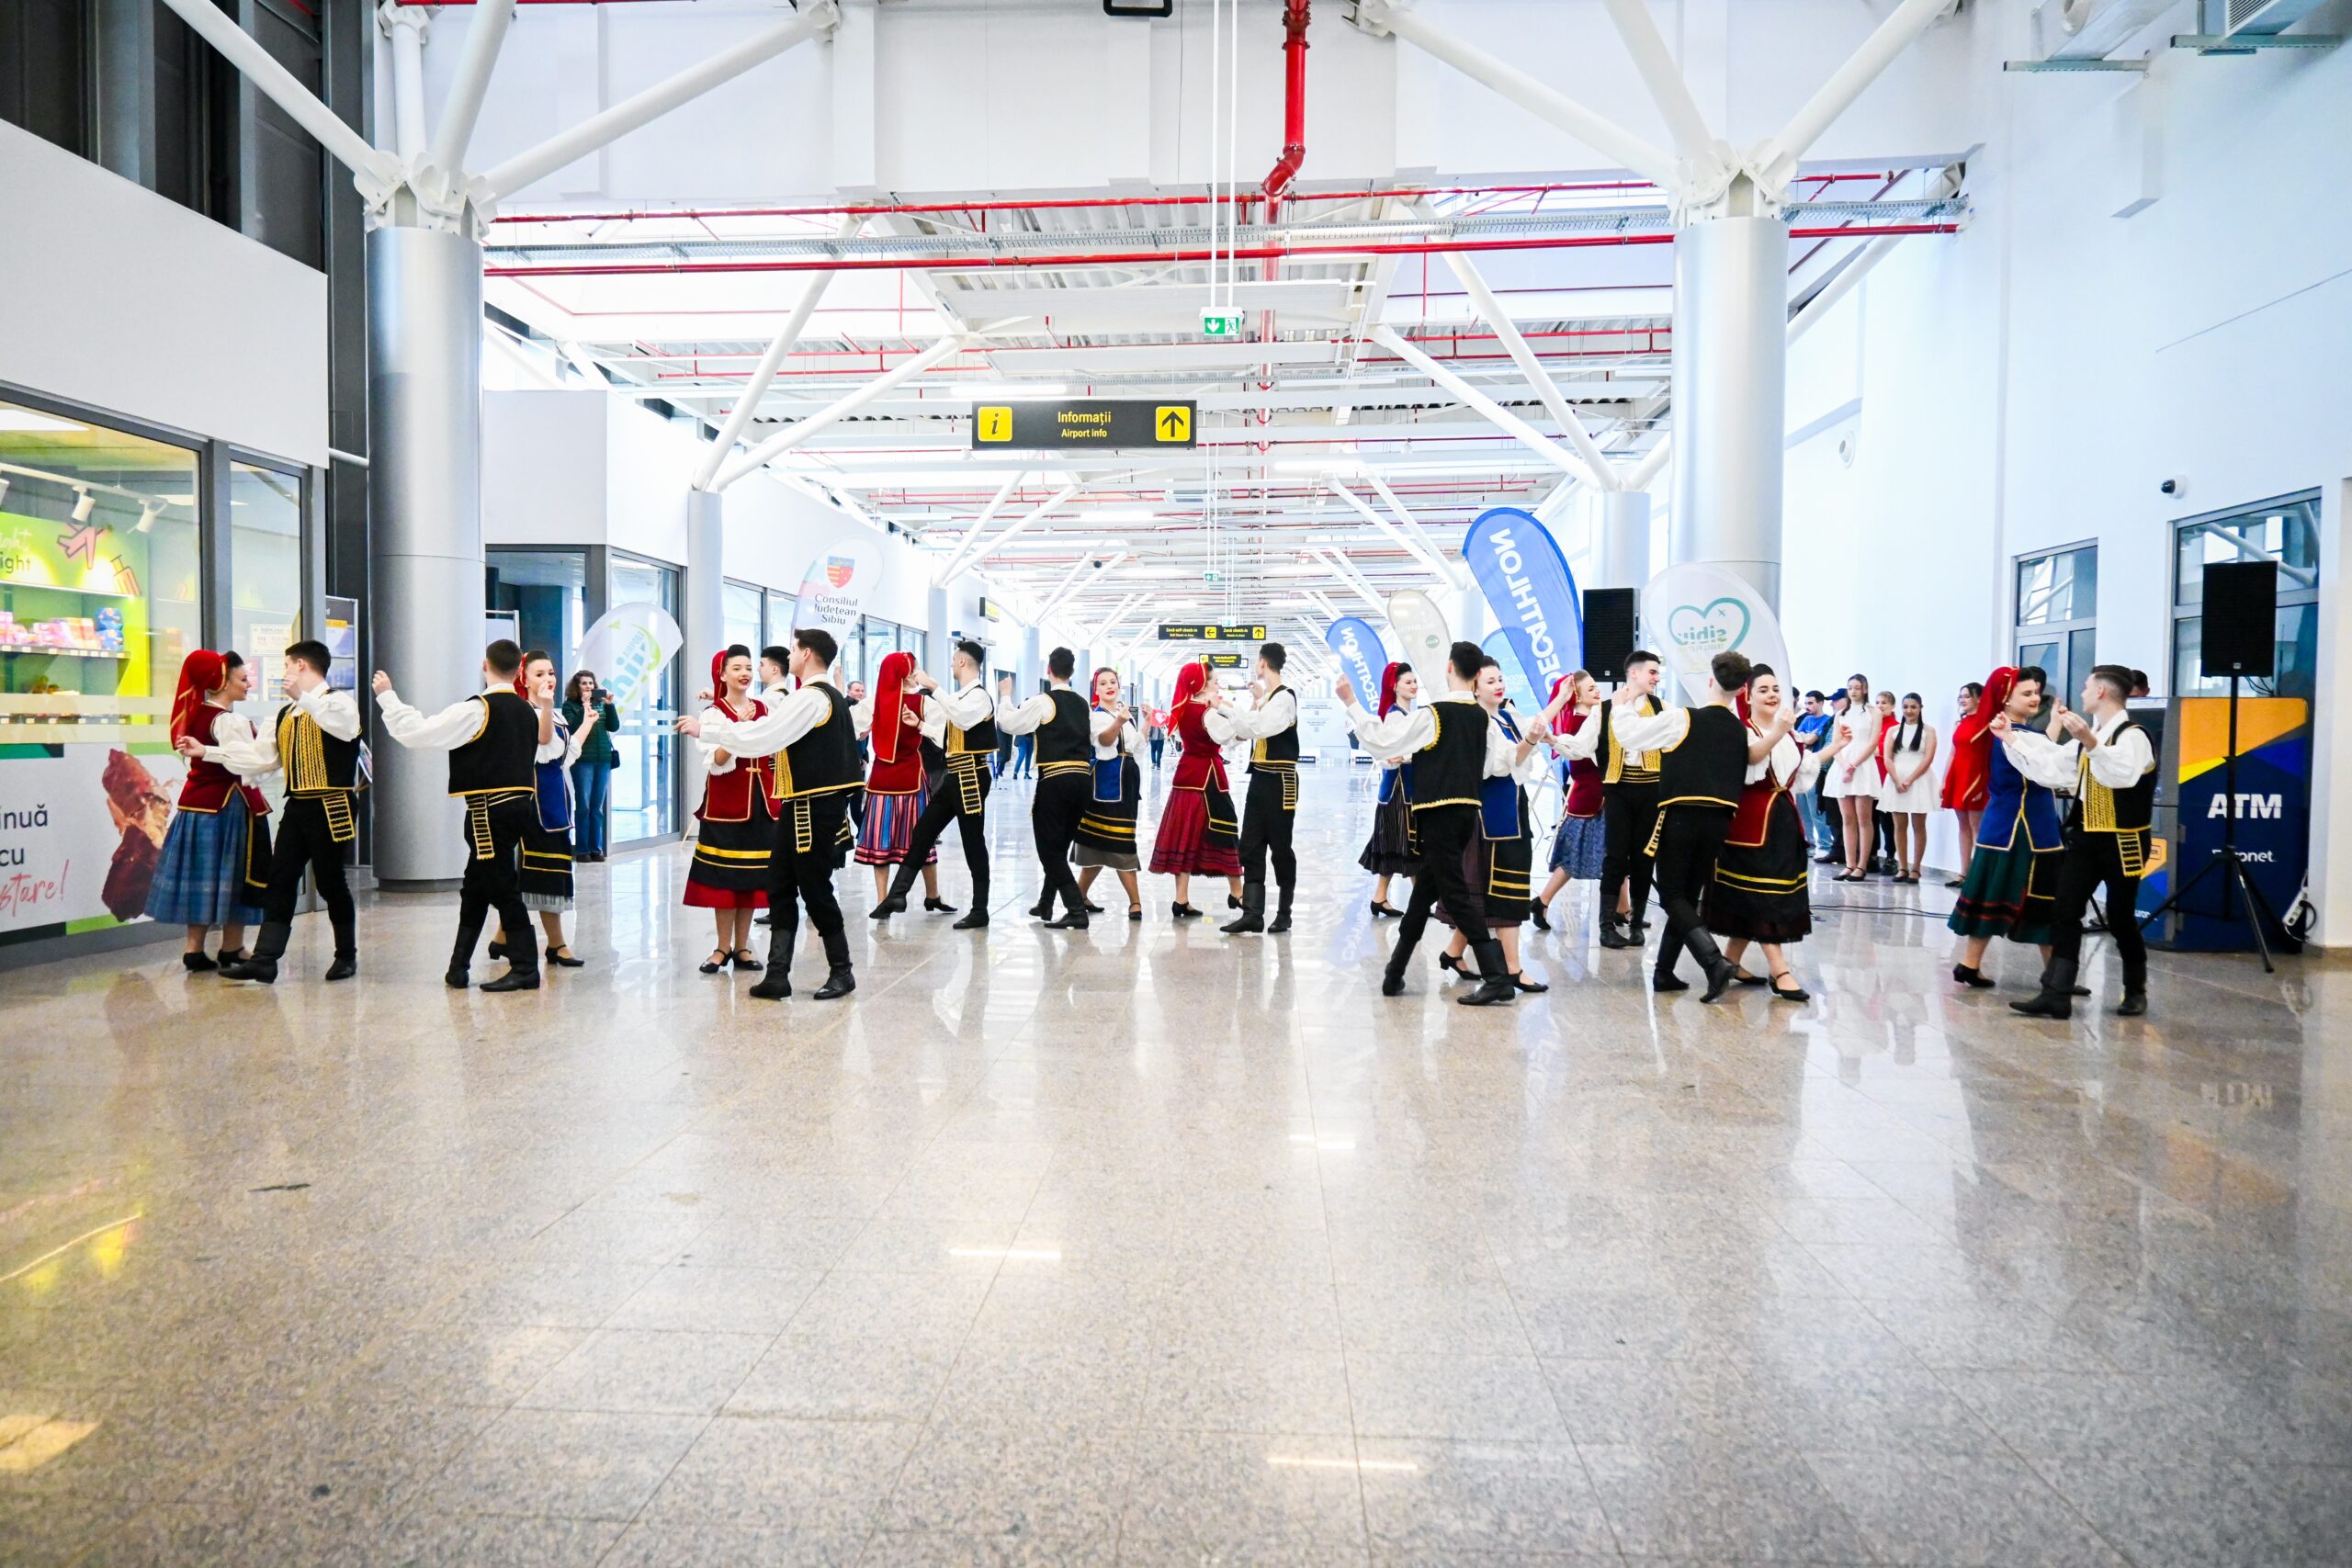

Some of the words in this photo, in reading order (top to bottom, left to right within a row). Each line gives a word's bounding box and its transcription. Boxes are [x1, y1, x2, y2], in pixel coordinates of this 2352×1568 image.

[1061, 428, 1091, 439] Airport
[1091, 428, 1108, 438] info
[815, 592, 858, 607] Consiliul
[821, 614, 846, 625] Sibiu
[2207, 794, 2282, 819] ATM
